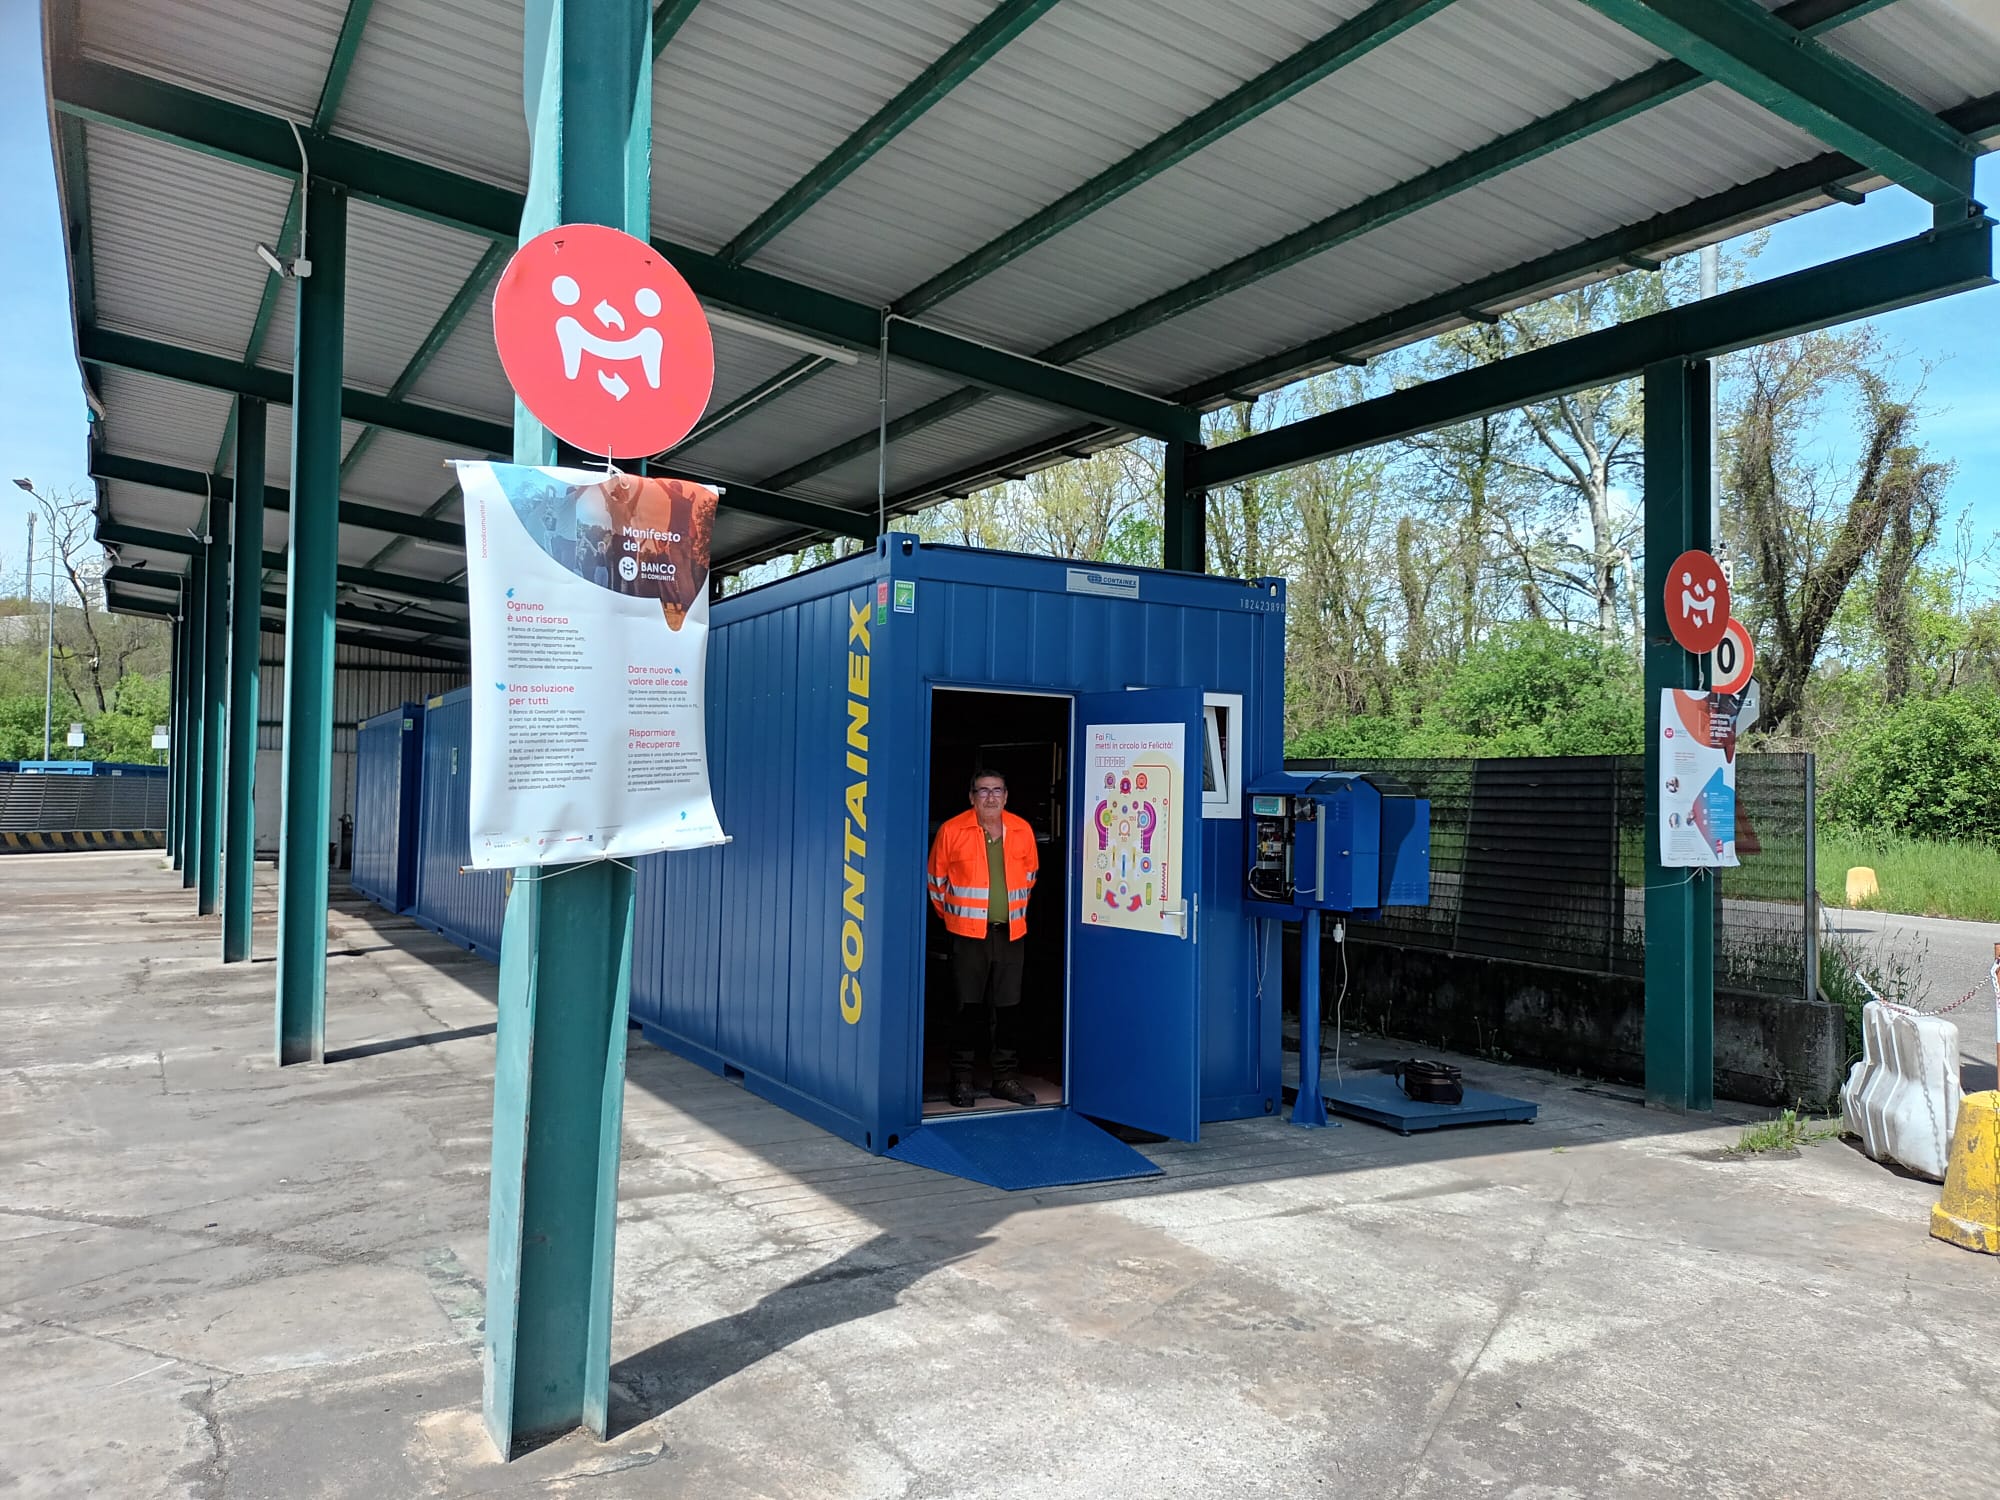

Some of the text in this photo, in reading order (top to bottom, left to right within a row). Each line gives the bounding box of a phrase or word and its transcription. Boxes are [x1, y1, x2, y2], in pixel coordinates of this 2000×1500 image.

[622, 526, 680, 542] Manifesto
[623, 539, 640, 552] del
[641, 562, 676, 574] BANCO
[1103, 577, 1136, 585] CONTAINEX
[507, 600, 544, 611] Ognuno
[507, 614, 513, 622] è
[536, 615, 568, 624] risorsa
[628, 665, 648, 674] Dare
[628, 678, 654, 686] valore
[655, 678, 669, 686] alle
[509, 684, 574, 692] Una soluzione
[509, 697, 548, 706] per tutti
[629, 729, 676, 738] Risparmiare
[635, 741, 680, 750] Recuperare
[840, 598, 870, 1025] CONTAINEX
